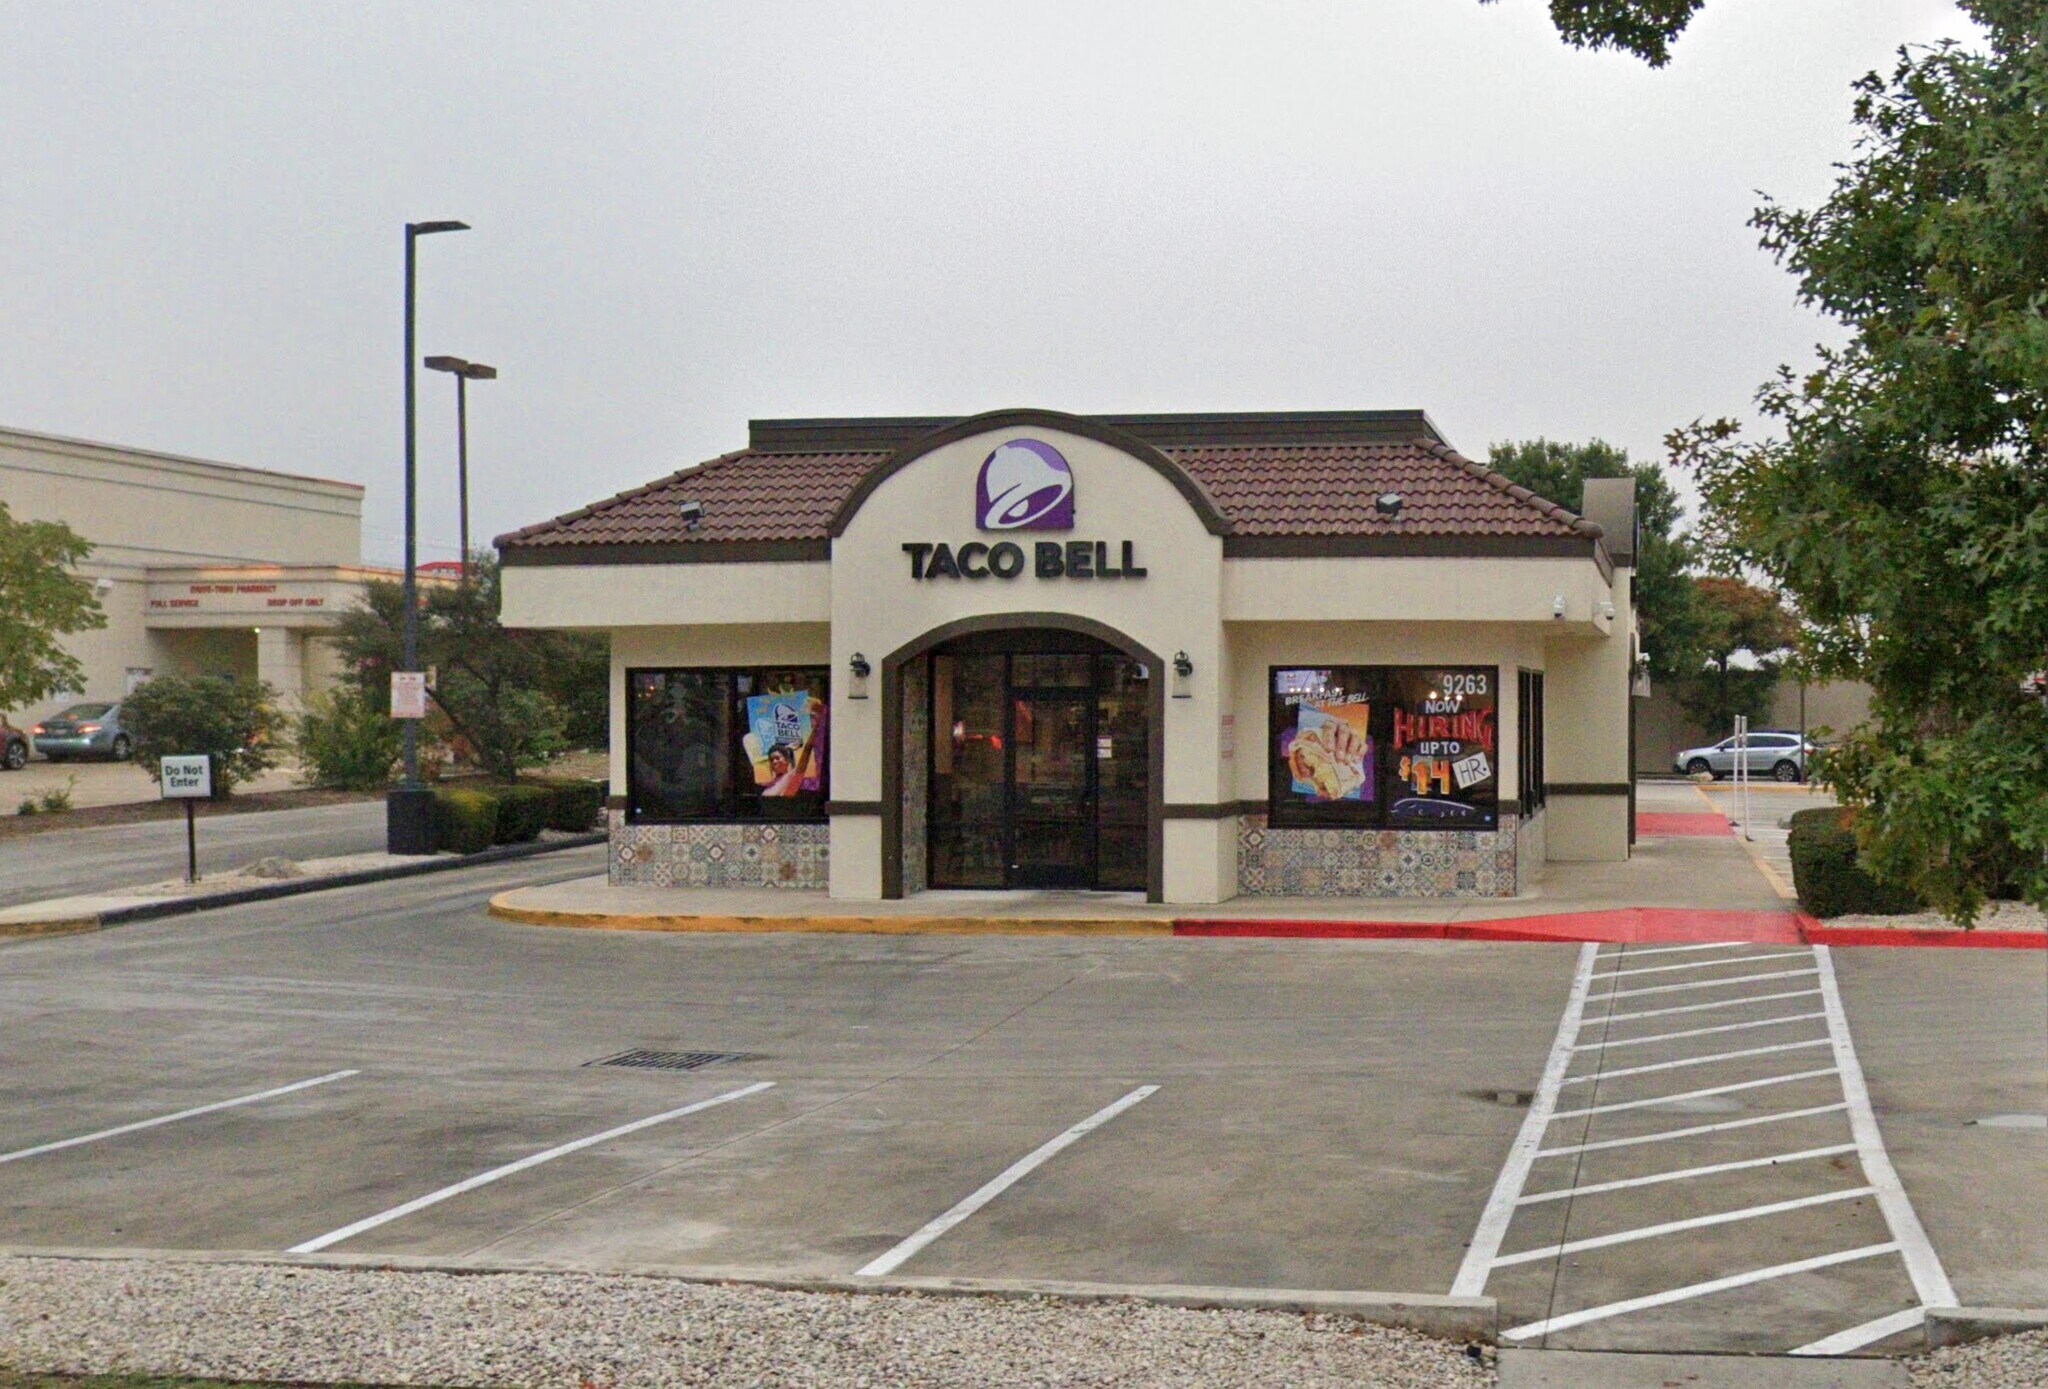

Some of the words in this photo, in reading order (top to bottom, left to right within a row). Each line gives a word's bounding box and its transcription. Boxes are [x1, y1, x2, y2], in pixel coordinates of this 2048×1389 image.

[902, 541, 1025, 579] TACO
[1035, 540, 1148, 578] BELL
[1443, 674, 1487, 694] 9263
[1285, 687, 1345, 706] BREAKFAST
[1328, 696, 1346, 707] THE
[1425, 700, 1461, 714] NOW
[776, 722, 800, 731] TACO
[1394, 704, 1494, 752] HIRING
[778, 730, 801, 738] BELL
[165, 766, 180, 776] Do
[183, 765, 203, 775] Not
[170, 777, 199, 787] Enter
